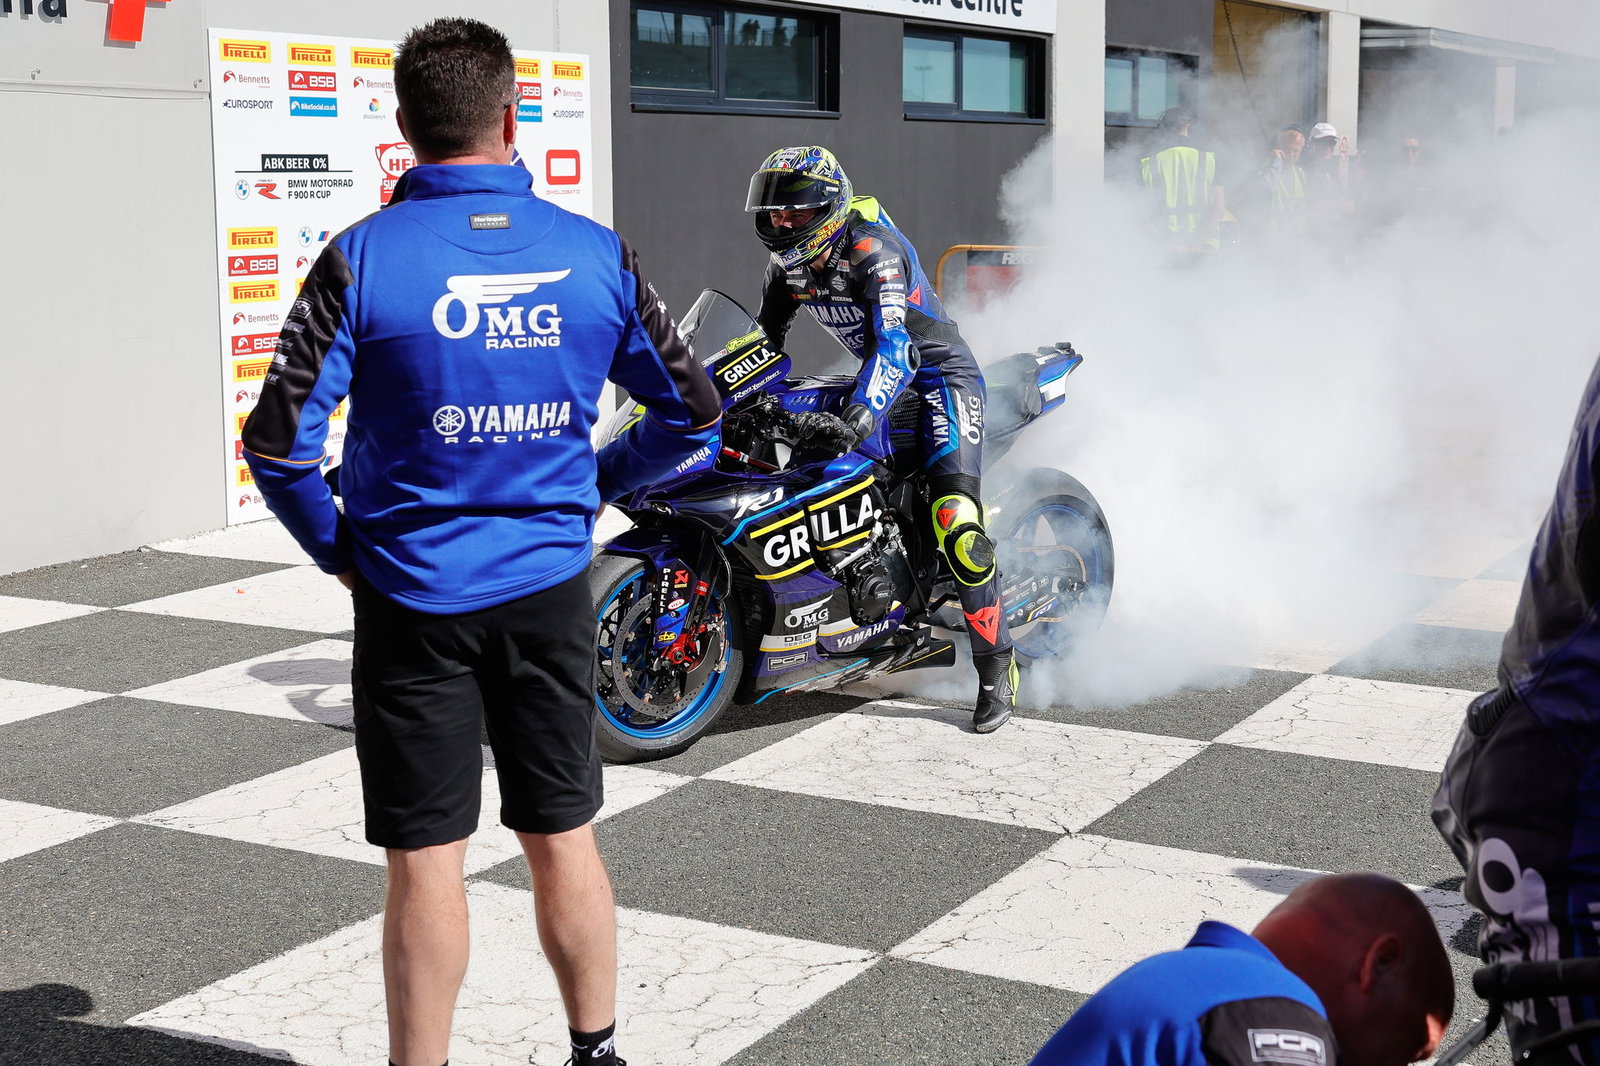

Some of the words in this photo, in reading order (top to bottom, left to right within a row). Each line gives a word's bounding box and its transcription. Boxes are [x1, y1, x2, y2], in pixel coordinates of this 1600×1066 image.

[223, 43, 266, 59] PIRELLI
[291, 47, 332, 62] PIRELLI
[354, 51, 391, 66] PIRELLI
[514, 61, 538, 75] RELLI
[554, 64, 581, 77] PIRELLI
[238, 74, 270, 84] Bennetts
[309, 76, 335, 88] BSB
[366, 79, 394, 89] Bennetts
[522, 86, 541, 96] BSB
[226, 99, 273, 110] EUROSPORT
[264, 157, 285, 170] ABK
[286, 157, 310, 170] BEER
[313, 157, 327, 169] 0%
[288, 179, 307, 188] BMW
[310, 179, 353, 188] MOTORRAD
[288, 191, 293, 199] F
[294, 191, 309, 199] 900
[310, 190, 315, 199] R
[316, 190, 331, 199] CUP
[474, 216, 507, 225] Harlequin
[231, 231, 273, 245] PIRELLI
[249, 259, 277, 271] BSB
[233, 284, 275, 299] PIRELLI
[248, 313, 279, 323] Bennetts
[432, 291, 562, 340] OMG
[485, 336, 561, 350] RACING
[724, 347, 776, 383] GRILLA.
[467, 401, 571, 433] YAMAHA
[328, 432, 344, 441] netts
[444, 429, 561, 444] RACING
[675, 446, 712, 474] YAMAHA
[763, 493, 882, 568] GRILLA.
[660, 567, 671, 614] PIRELLI
[784, 607, 830, 628] OMG
[657, 631, 677, 642] sbs
[784, 632, 812, 643] DEG
[836, 619, 890, 649] YAMAHA
[770, 653, 806, 665] PCR
